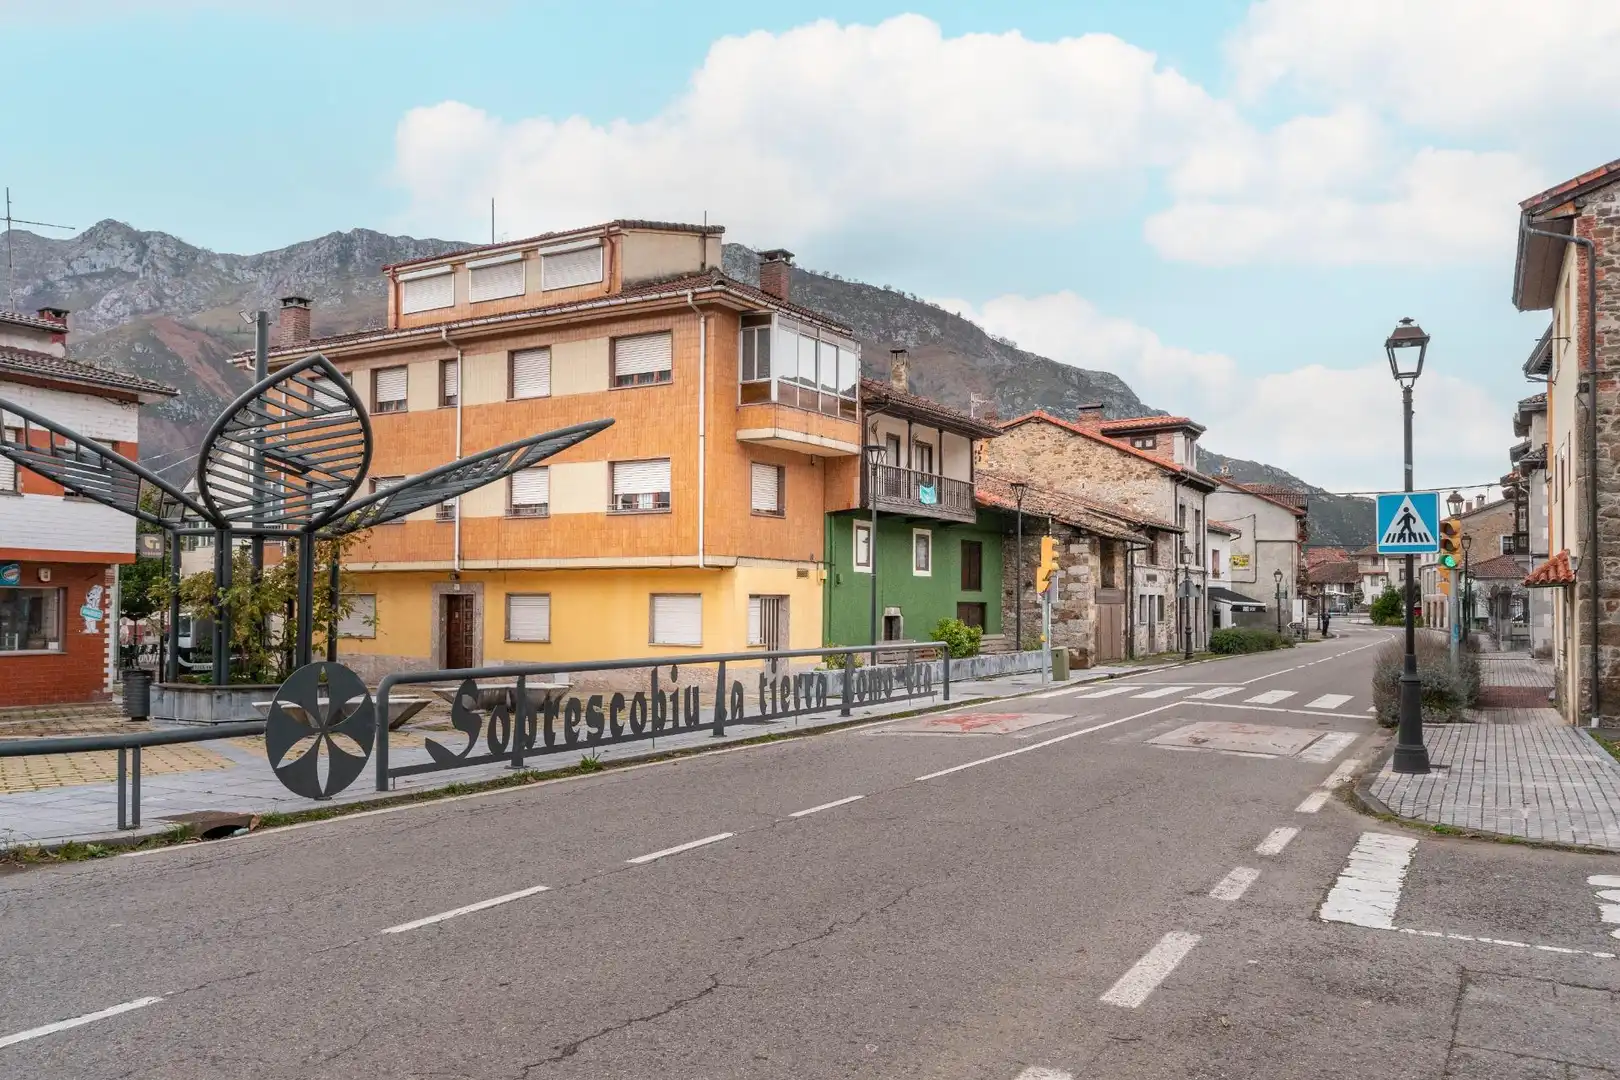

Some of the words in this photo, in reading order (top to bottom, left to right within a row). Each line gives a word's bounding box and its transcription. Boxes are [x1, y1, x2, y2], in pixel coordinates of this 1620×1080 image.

[425, 664, 699, 763] Sobrescobiu
[758, 656, 828, 716] tierra
[842, 666, 893, 703] omo
